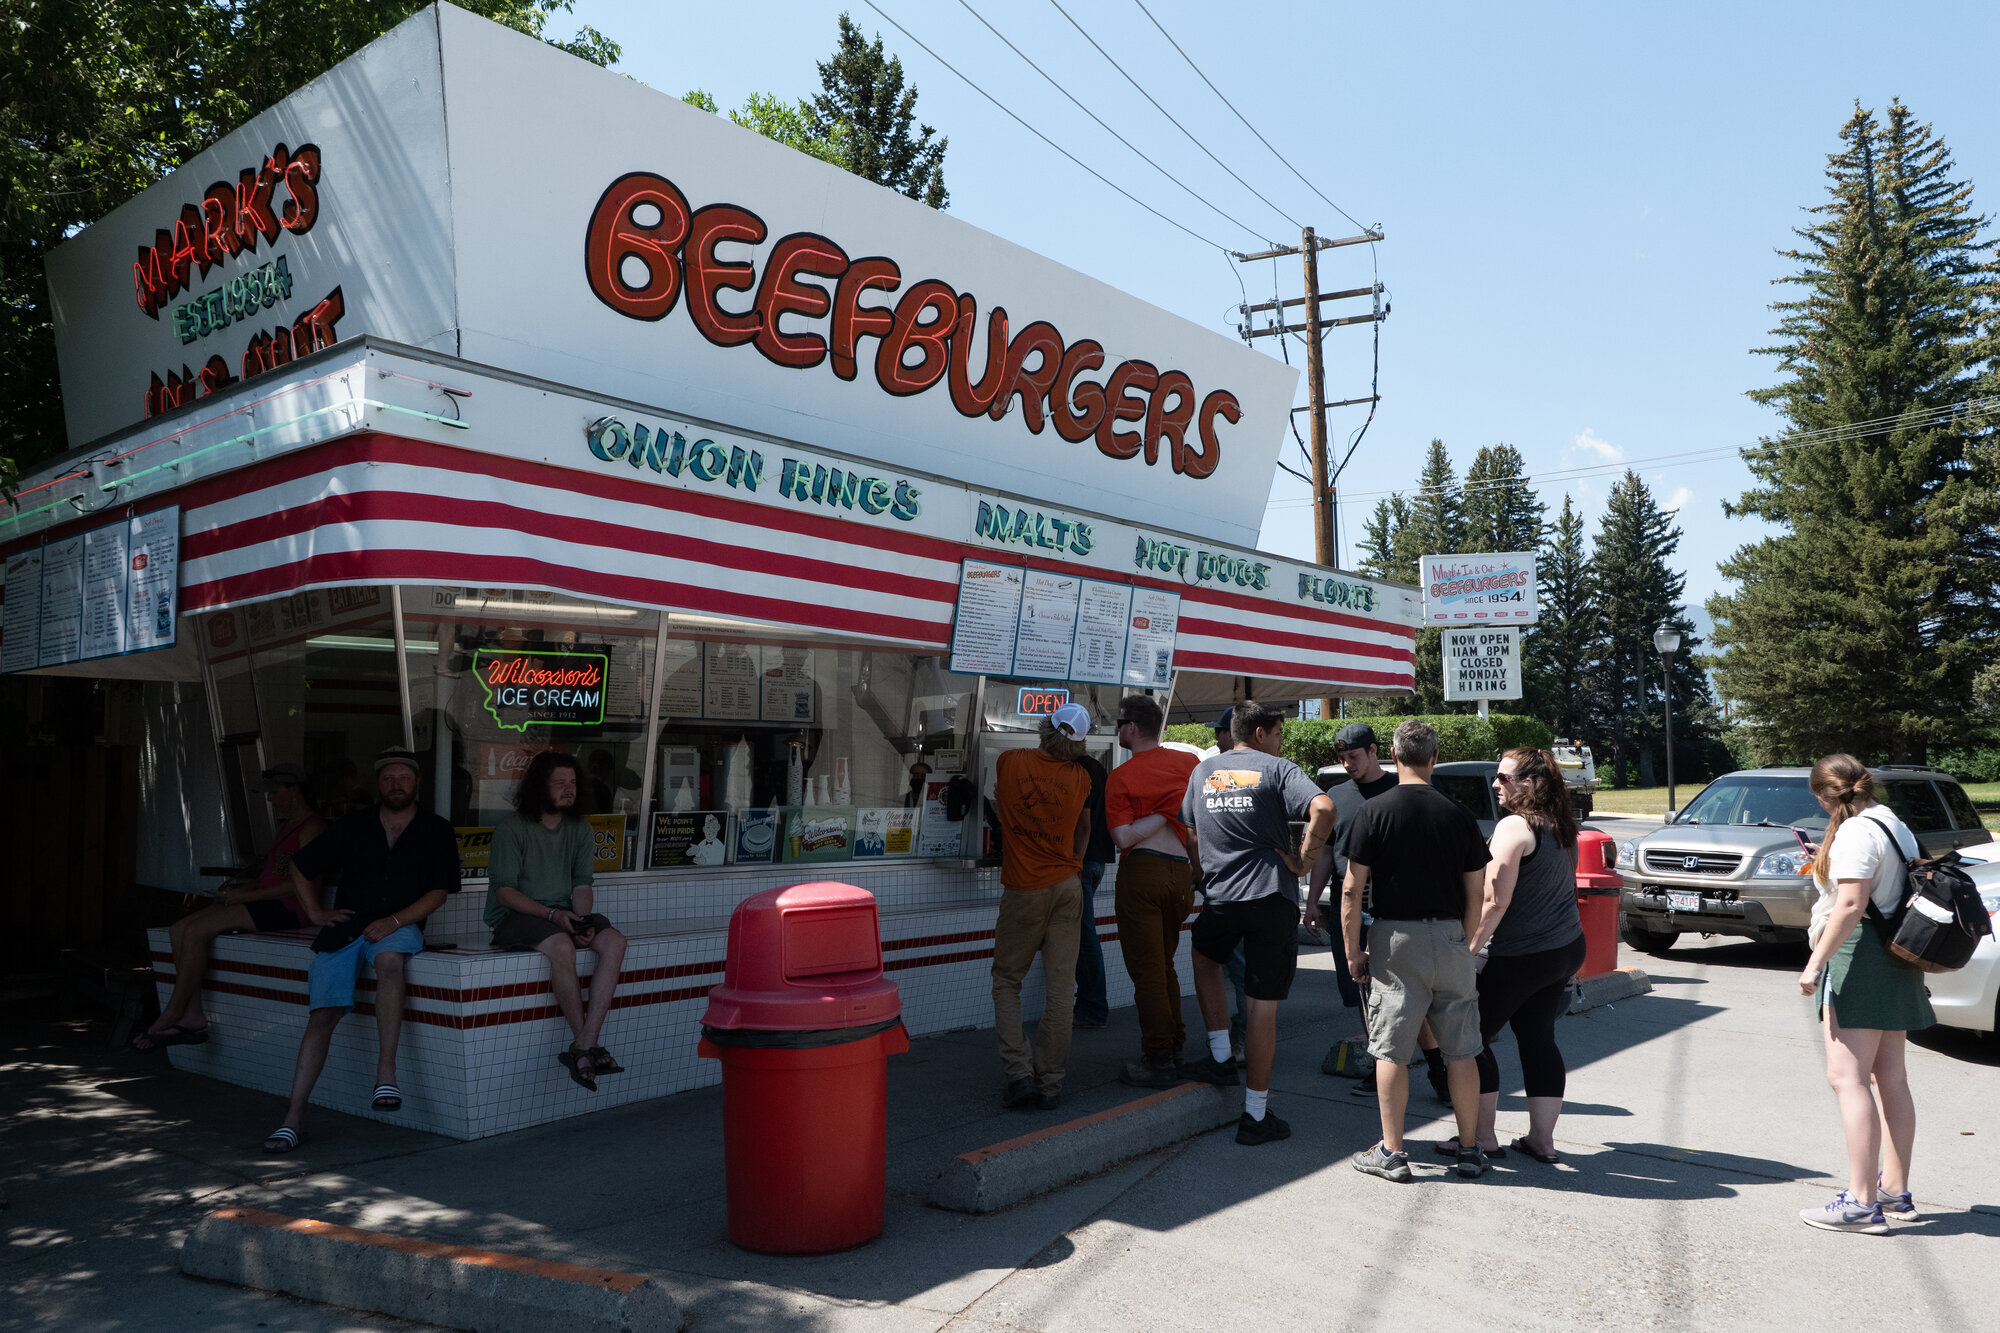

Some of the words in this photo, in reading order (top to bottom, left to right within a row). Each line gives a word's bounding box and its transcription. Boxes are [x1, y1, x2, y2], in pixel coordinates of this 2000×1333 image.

[134, 142, 321, 320] MARK'S
[222, 254, 293, 323] 1954
[584, 171, 1243, 479] BEEFBURGERS
[588, 415, 767, 493] ONION
[779, 457, 923, 521] RINGS
[975, 500, 1097, 556] MALTS
[1135, 535, 1193, 577] HOT
[1197, 551, 1272, 591] DOGS
[1474, 566, 1481, 574] &
[1481, 565, 1495, 574] Out
[966, 570, 1001, 579] BEEFBURGERS
[1431, 570, 1529, 598] BEEFBURGERS
[1298, 573, 1380, 612] FLOATS
[1452, 635, 1475, 645] NOW
[1480, 634, 1510, 644] OPEN
[1452, 646, 1478, 657] 11AM
[1486, 645, 1510, 656] 8PM
[488, 658, 601, 687] Wilcoxson's
[1460, 658, 1503, 668] CLOSED
[1459, 669, 1507, 680] MONDAY
[1459, 680, 1507, 692] HIRING
[496, 687, 528, 706] ICE
[533, 689, 600, 708] CREAM
[1022, 693, 1064, 713] OPEN
[1206, 796, 1253, 809] BAKER
[656, 826, 677, 835] WITH
[658, 816, 671, 825] WE
